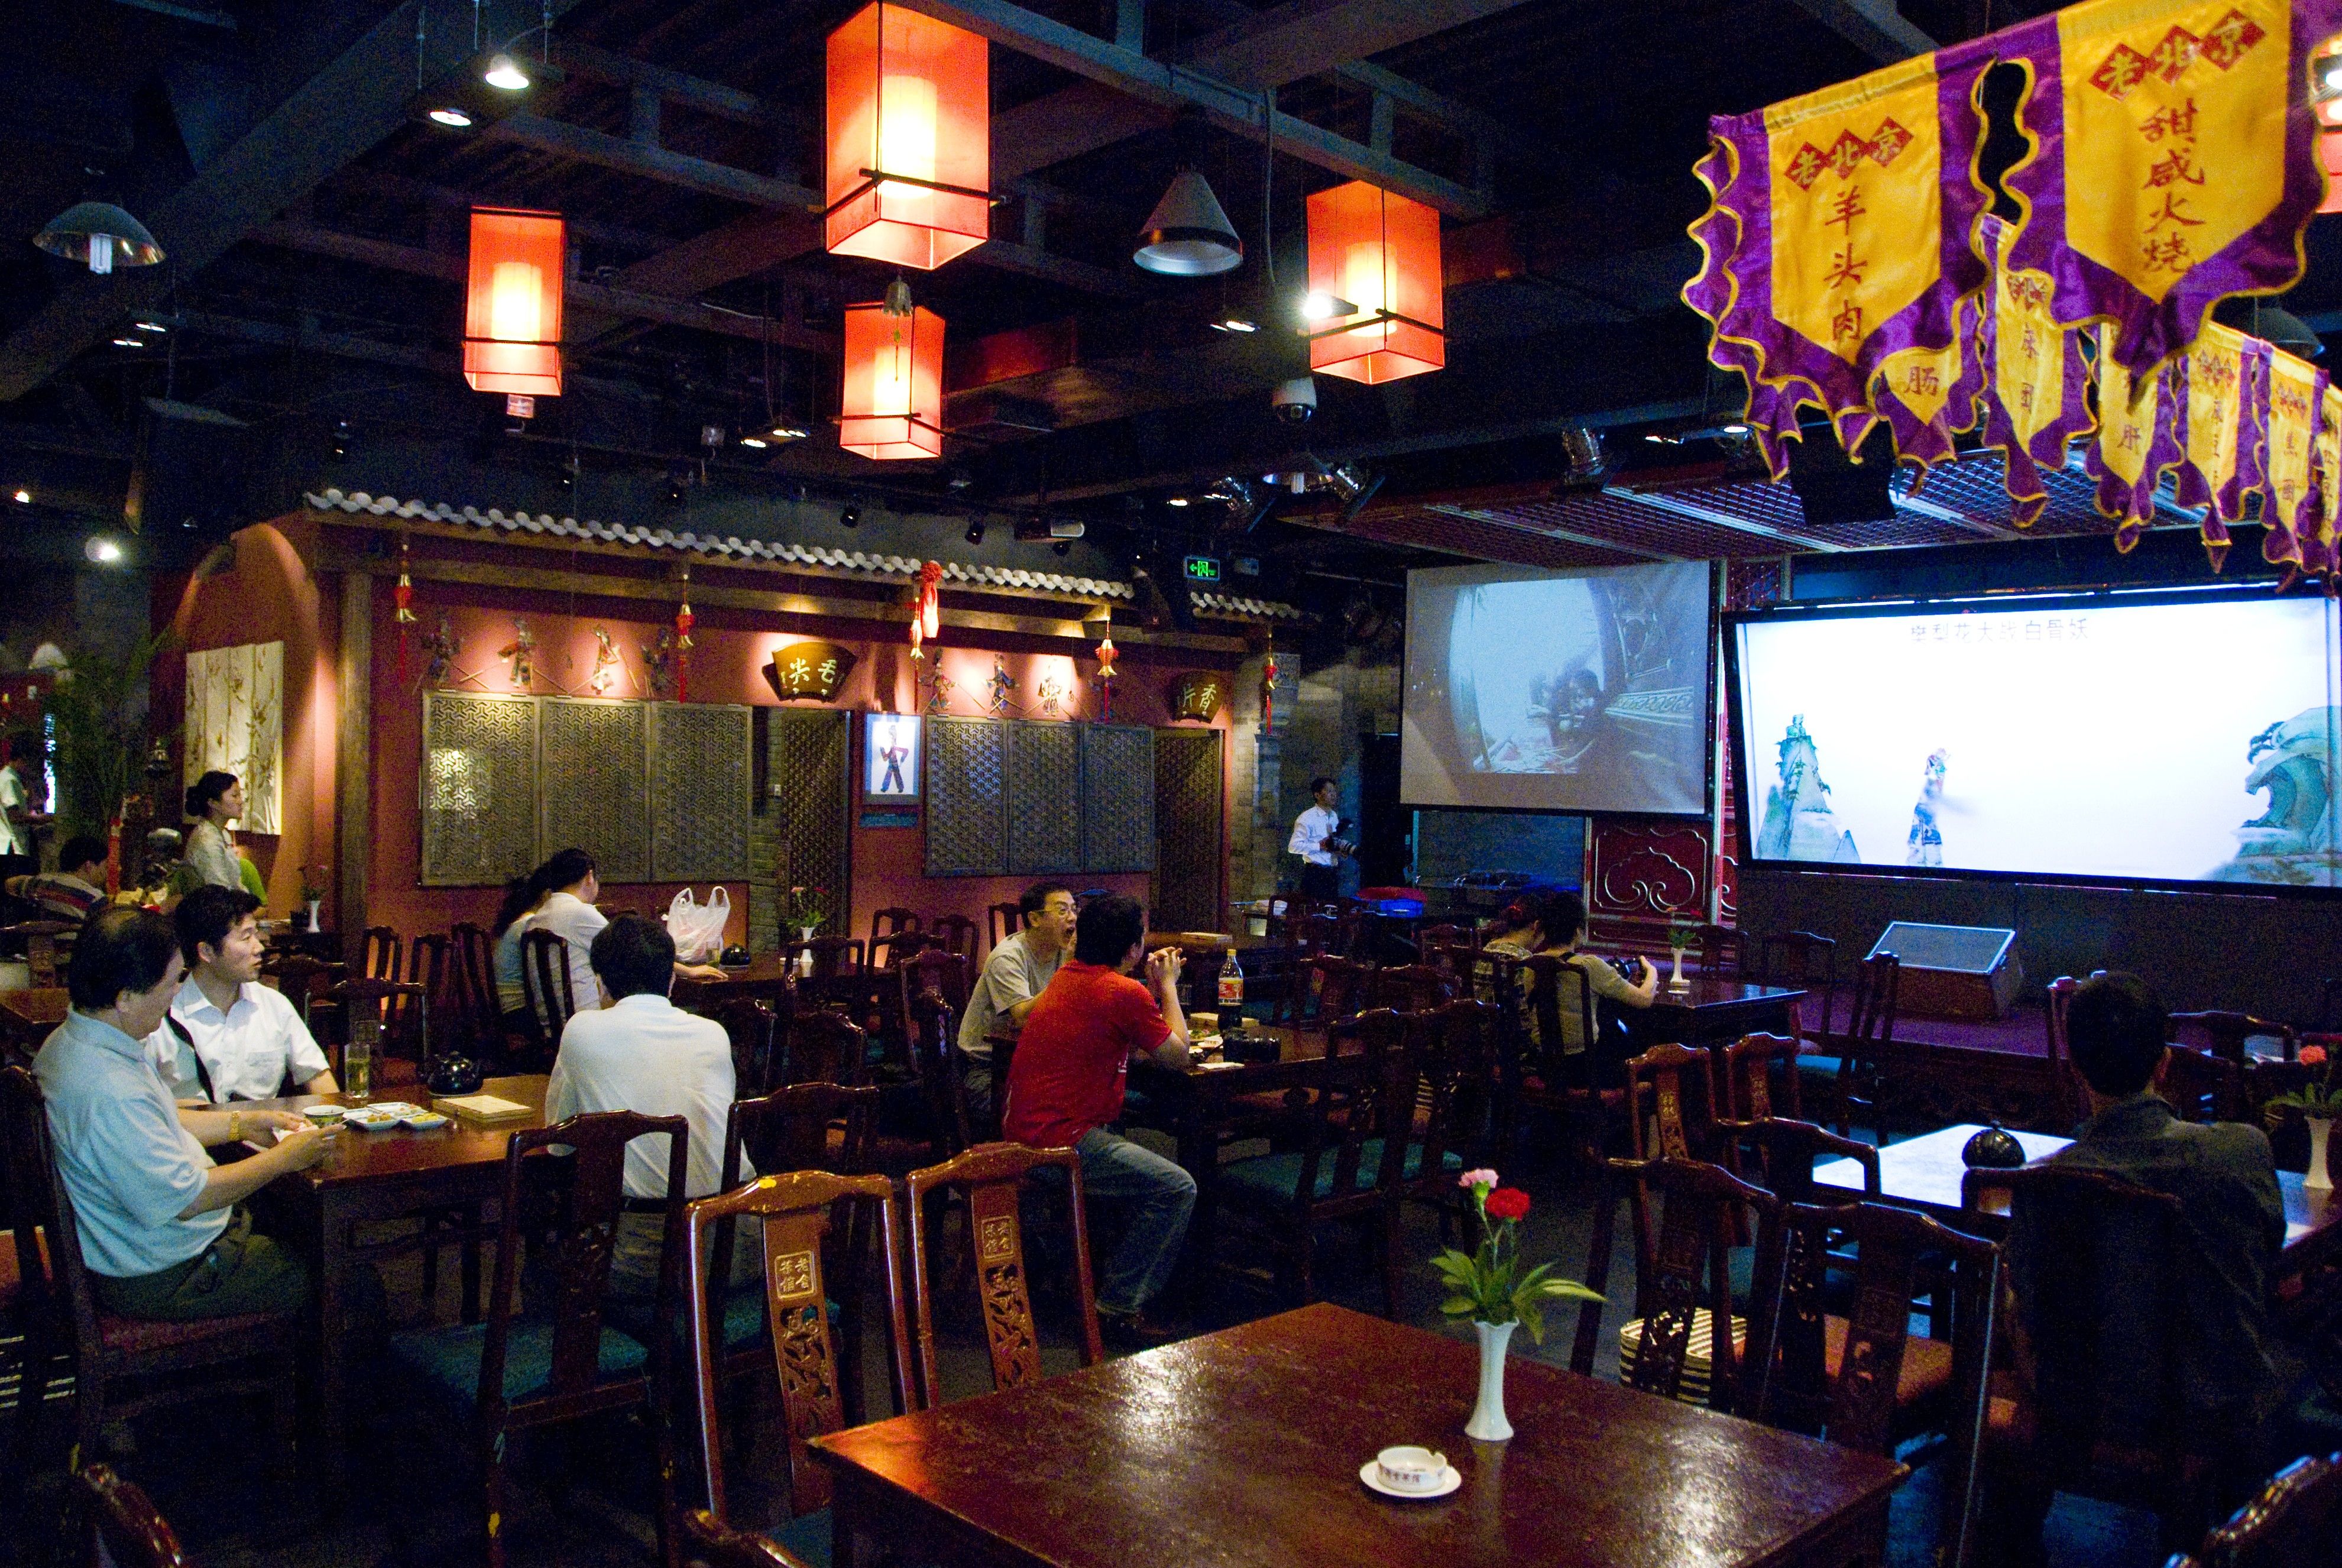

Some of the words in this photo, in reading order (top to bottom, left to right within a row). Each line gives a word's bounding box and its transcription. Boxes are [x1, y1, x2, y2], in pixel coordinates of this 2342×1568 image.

[2097, 15, 2249, 98] 老北京
[1789, 123, 1904, 186] 老北京
[1825, 185, 1867, 341] 羊头肉
[1904, 366, 1939, 397] 肠
